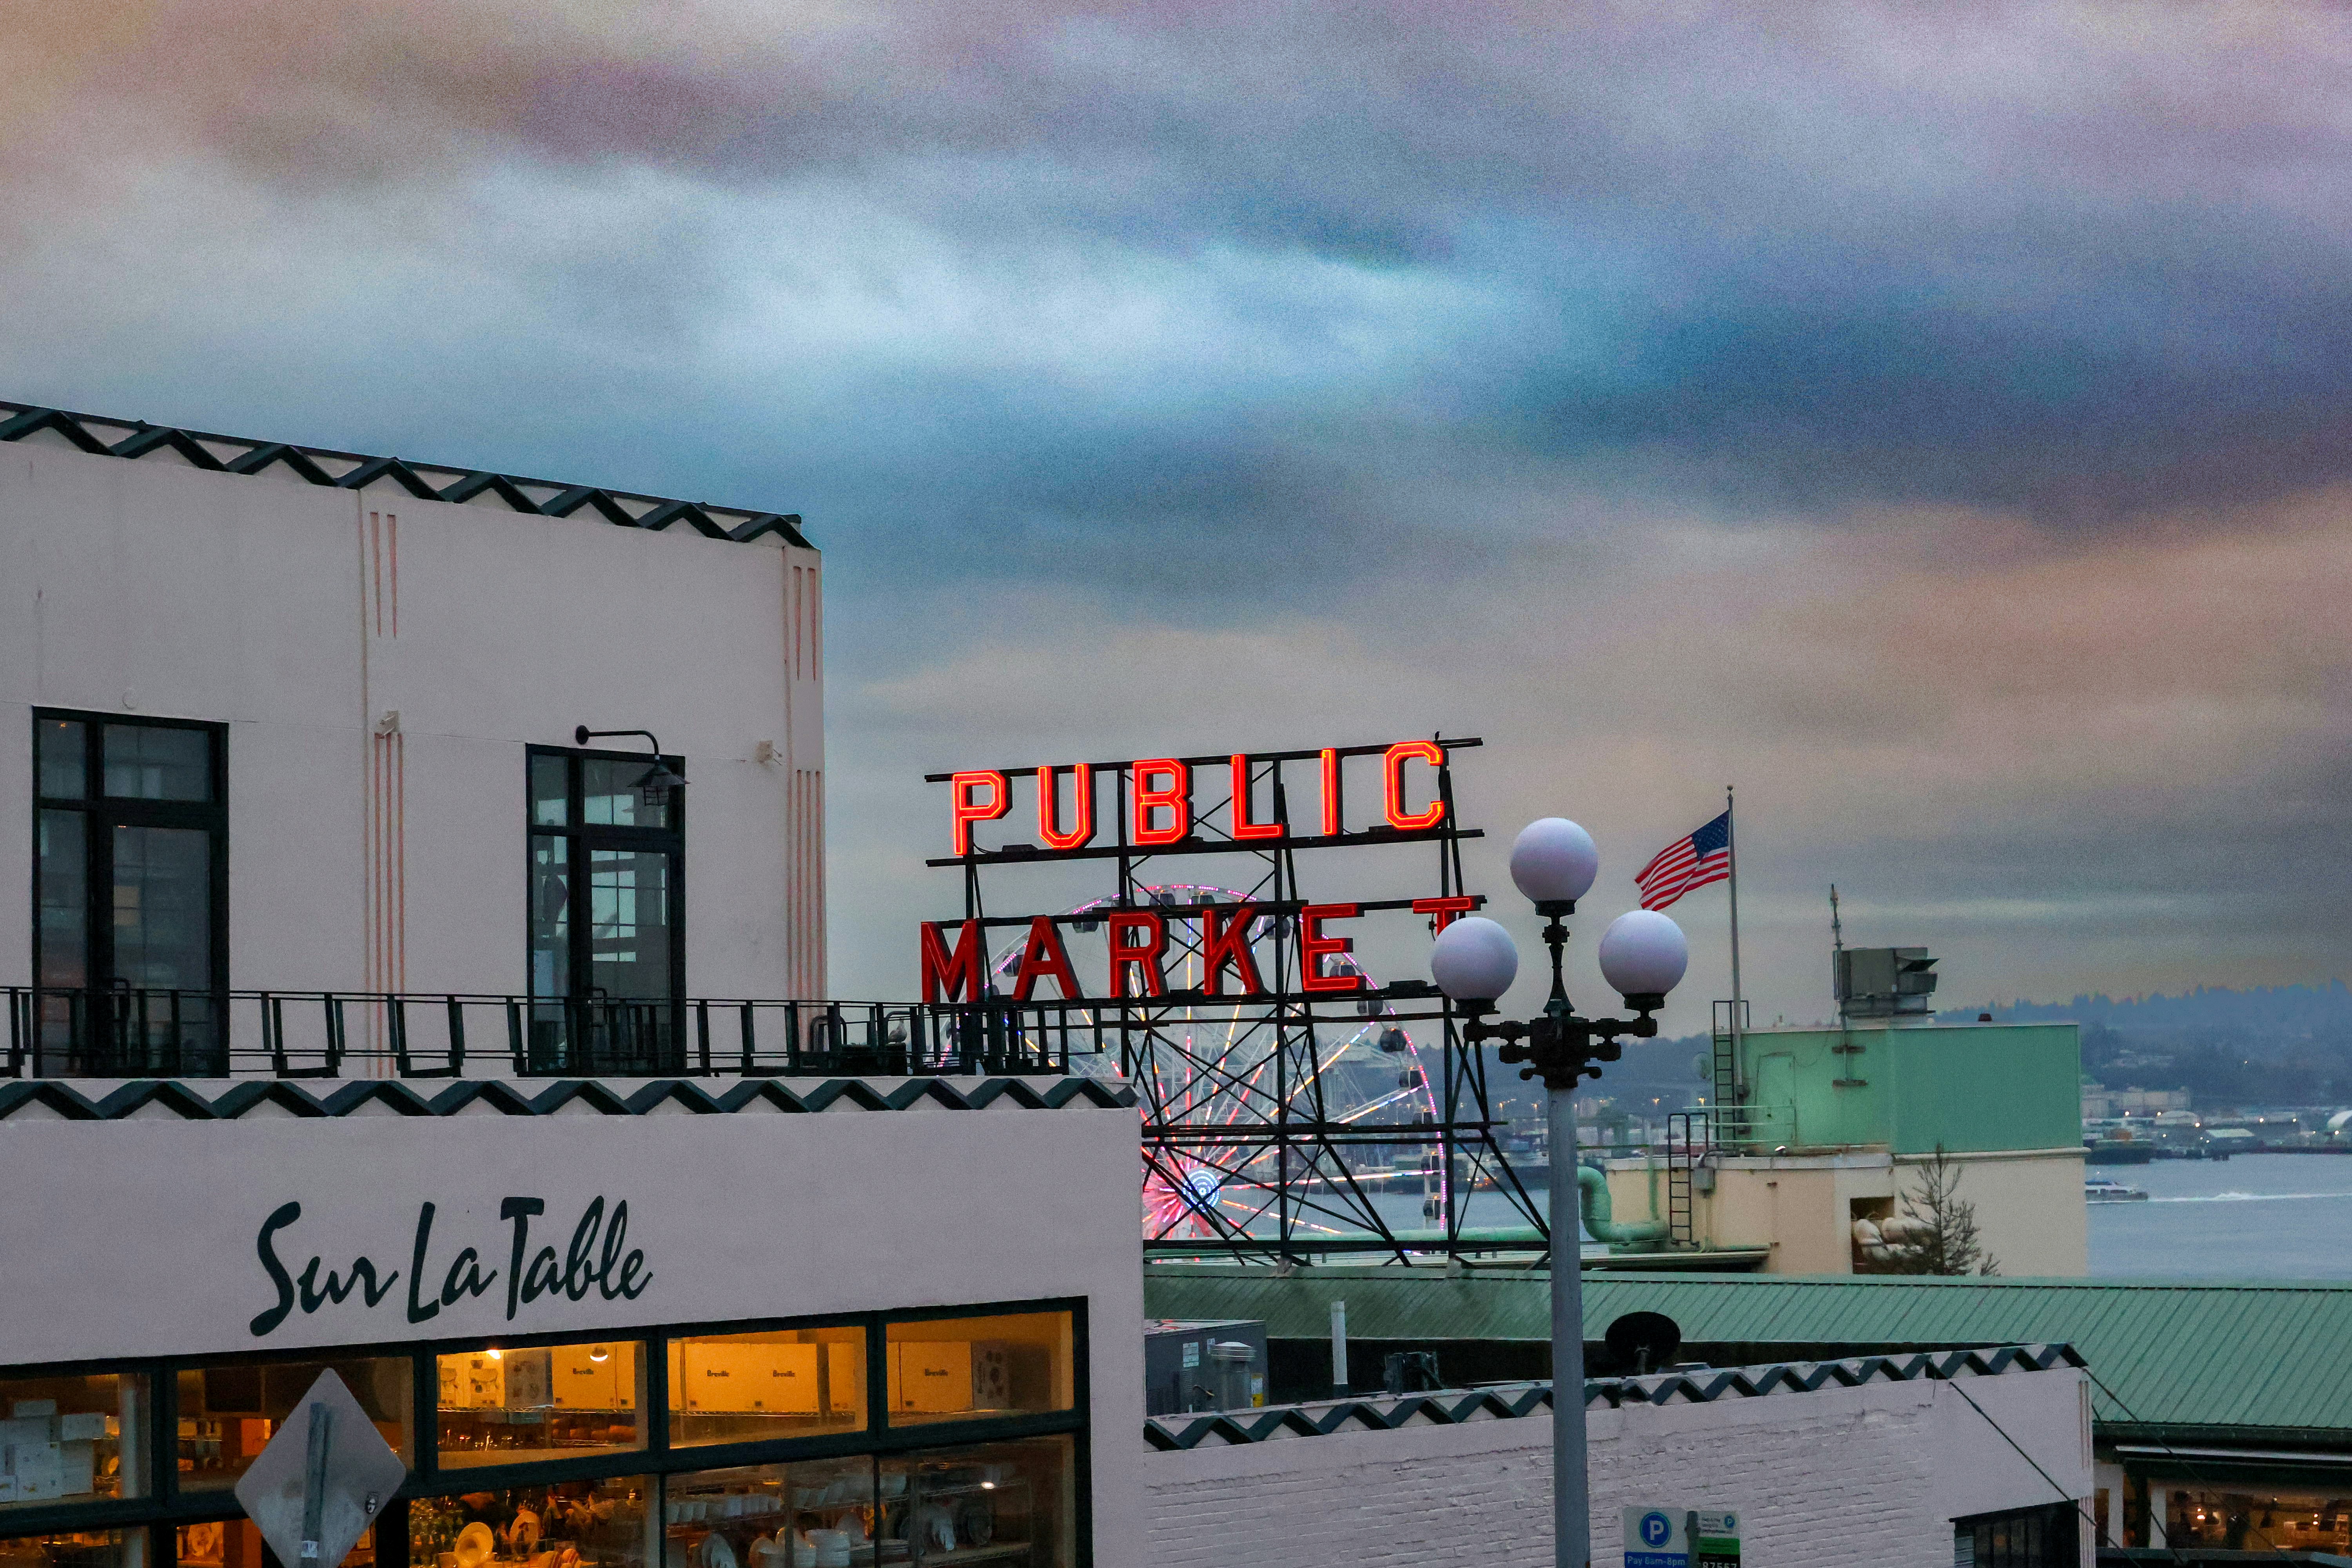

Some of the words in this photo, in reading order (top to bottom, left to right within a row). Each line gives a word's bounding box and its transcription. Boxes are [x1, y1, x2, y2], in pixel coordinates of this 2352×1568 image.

[952, 740, 1445, 855] PUBLIC
[249, 1201, 399, 1336] Sur
[407, 1201, 497, 1324] La
[500, 1195, 653, 1321] Table
[1627, 1555, 1642, 1566] Pay
[1649, 1520, 1664, 1540] P
